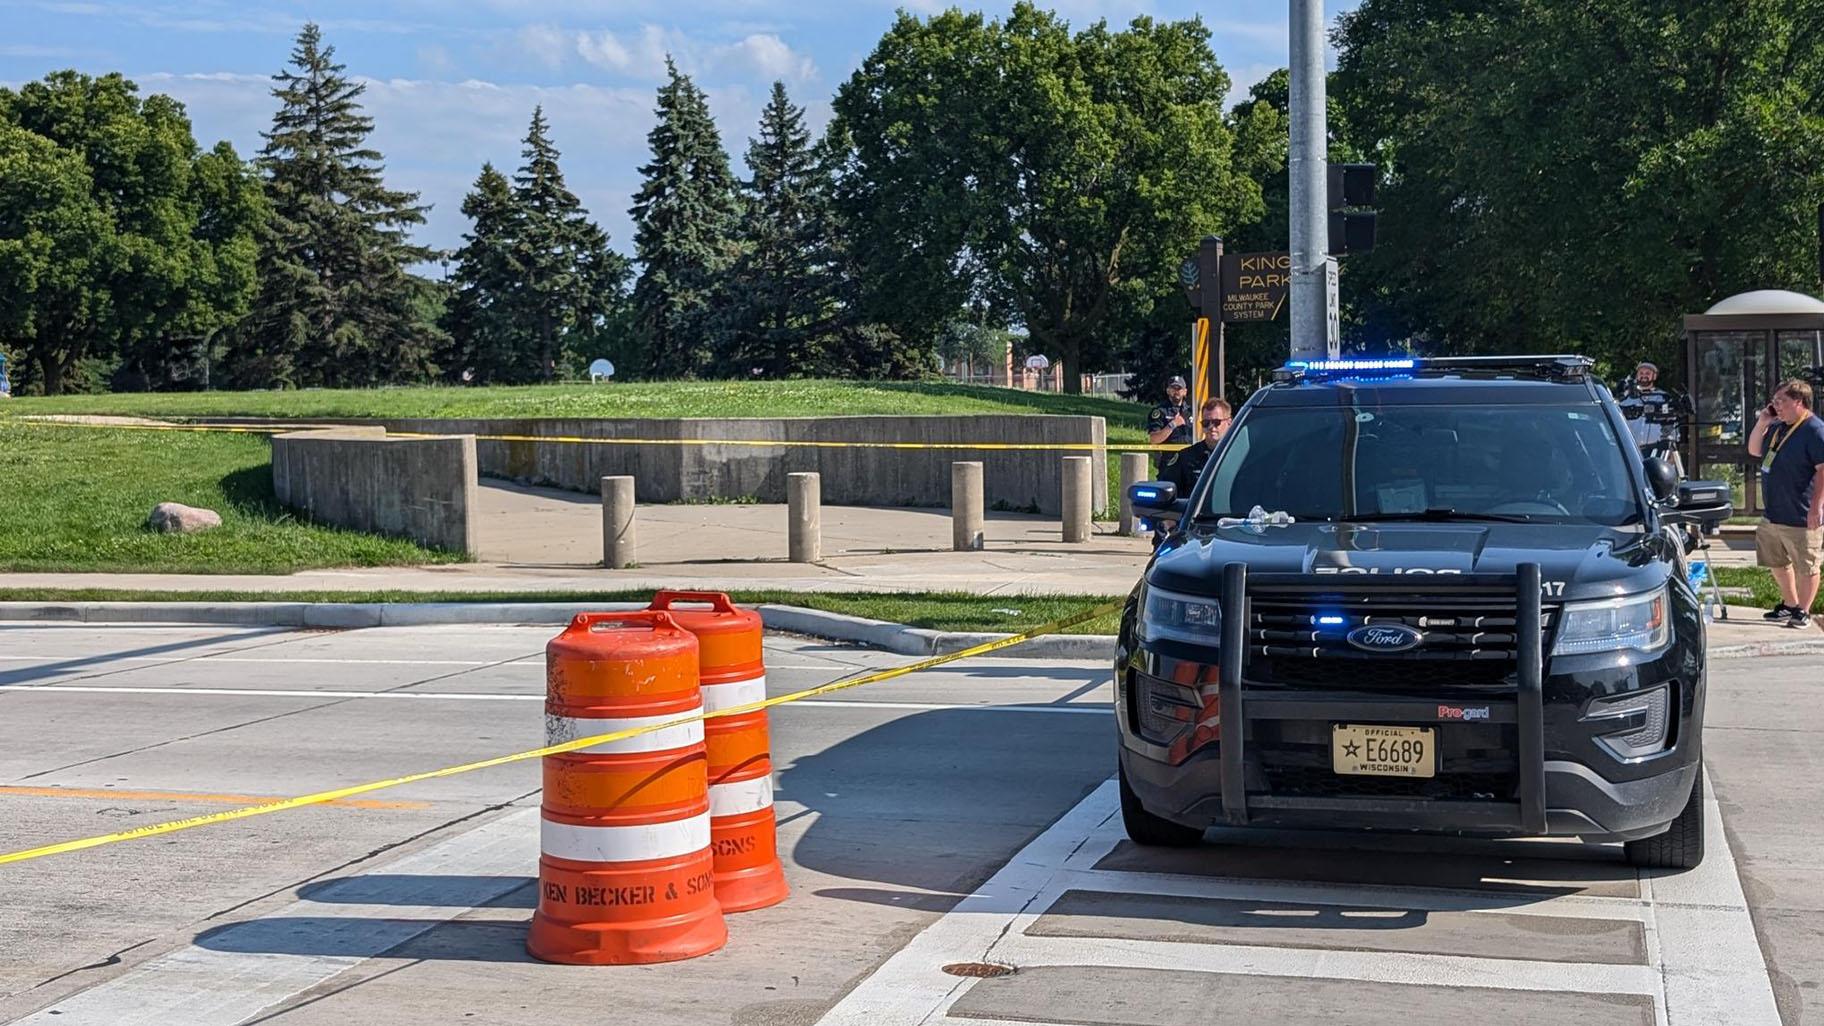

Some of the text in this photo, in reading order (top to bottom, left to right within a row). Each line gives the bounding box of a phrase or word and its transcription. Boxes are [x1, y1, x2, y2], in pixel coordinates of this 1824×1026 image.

[1241, 256, 1291, 271] KING
[1240, 273, 1292, 289] PARK
[1227, 292, 1269, 302] MILWAUKEE
[1223, 301, 1274, 311] COUNTY PARK
[1233, 310, 1264, 319] SYSTEM
[1540, 581, 1566, 596] 17
[1364, 629, 1404, 645] Ford
[1364, 729, 1404, 737] OFFICIAL
[1366, 738, 1424, 764] E6689
[1360, 763, 1409, 773] WISCONSIN
[543, 881, 567, 903] KEN
[575, 886, 655, 906] BECKER
[665, 882, 678, 900] &
